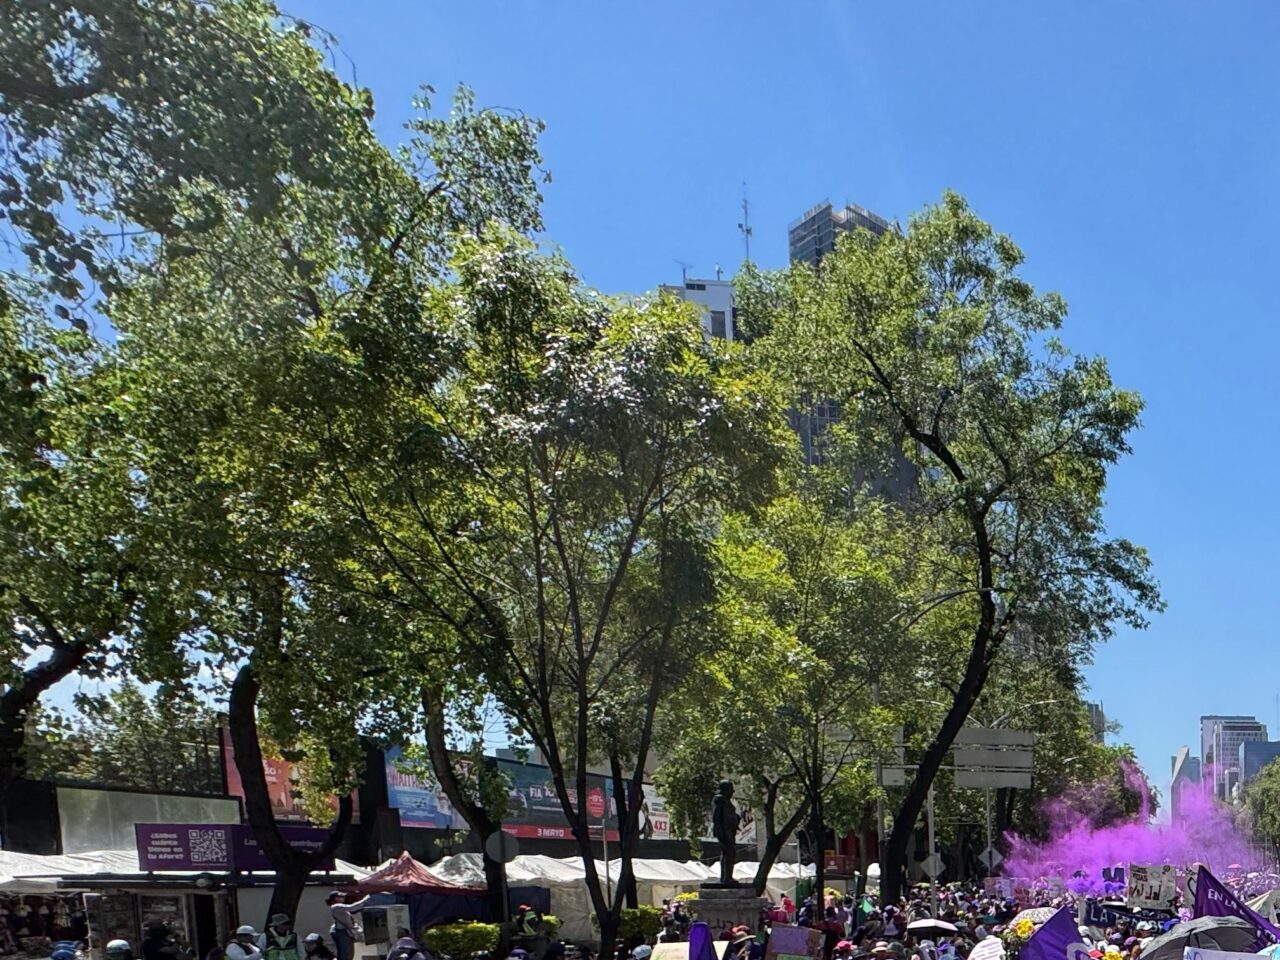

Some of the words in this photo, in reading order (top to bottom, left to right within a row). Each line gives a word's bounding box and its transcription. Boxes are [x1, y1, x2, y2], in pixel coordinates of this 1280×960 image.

[654, 819, 667, 831] 4X3
[537, 827, 542, 836] 3
[542, 828, 565, 837] MAYO
[1207, 888, 1223, 901] EN
[1090, 904, 1109, 923] LA
